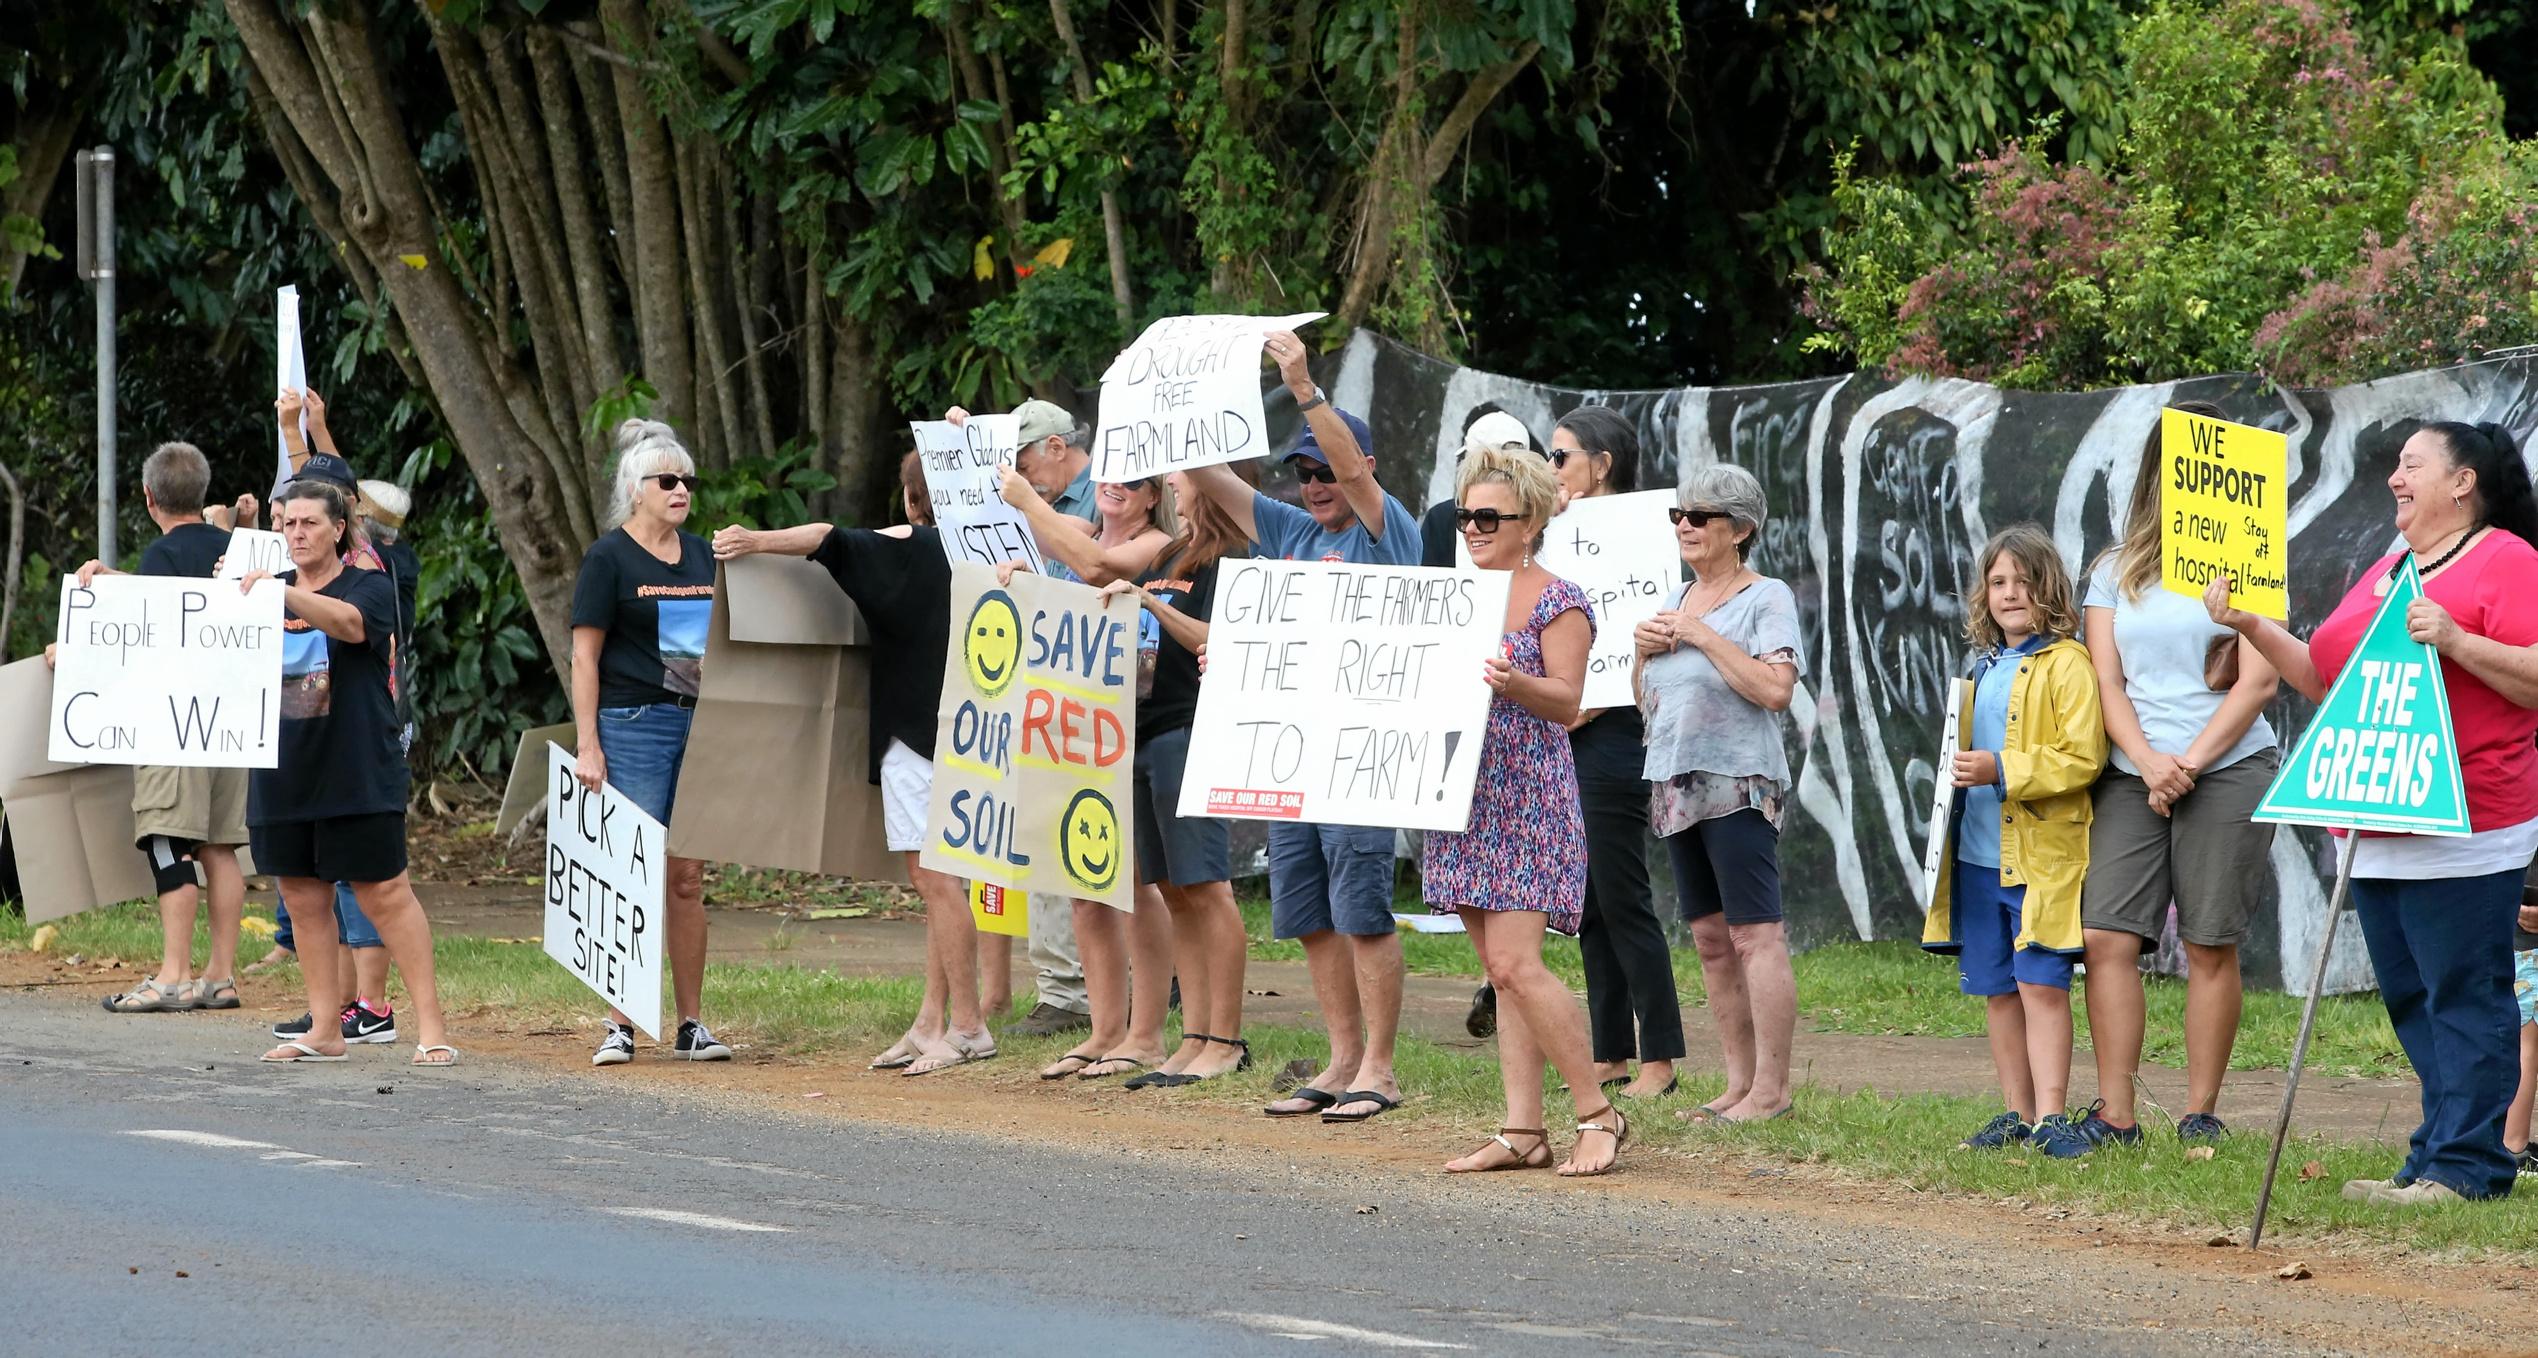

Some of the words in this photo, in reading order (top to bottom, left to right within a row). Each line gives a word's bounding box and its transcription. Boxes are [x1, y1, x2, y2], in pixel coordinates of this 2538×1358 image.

[1127, 332, 1248, 386] DROUGHT
[1152, 380, 1198, 414] FREE
[914, 428, 964, 472] Premier
[1101, 409, 1251, 477] FARMLAND
[2189, 418, 2226, 460] WE
[928, 487, 952, 519] you
[959, 477, 985, 507] need
[990, 476, 1004, 505] t
[2174, 455, 2267, 509] SUPPORT
[1570, 526, 1600, 556] to
[2173, 510, 2184, 536] a
[2188, 513, 2228, 545] new
[2243, 515, 2269, 544] Stay
[2255, 542, 2270, 561] off
[1225, 566, 1306, 624] GIVE
[1327, 572, 1377, 624] THE
[1380, 575, 1475, 627] FARMERS
[1586, 568, 1670, 621] spital
[2174, 547, 2244, 595] hospital
[1027, 610, 1127, 686] SAVE
[1233, 641, 1308, 692] THE
[1335, 639, 1441, 700] RIGHT
[1590, 653, 1634, 673] arm
[2356, 660, 2423, 727] THE
[952, 699, 1012, 776] OUR
[1021, 688, 1127, 768] RED
[1236, 720, 1304, 788] TO
[1327, 726, 1462, 806] FARM!
[2305, 726, 2439, 807] GREENS
[560, 764, 616, 858] PICK
[630, 824, 647, 886] A
[1209, 790, 1234, 804] SAVE
[1236, 792, 1256, 805] OUR
[1258, 794, 1278, 806] RED
[1280, 795, 1302, 808] SOIL
[943, 789, 1031, 866] SOIL
[549, 843, 645, 968] BETTER
[985, 885, 997, 914] SAVE
[573, 927, 625, 1004] SITE!
